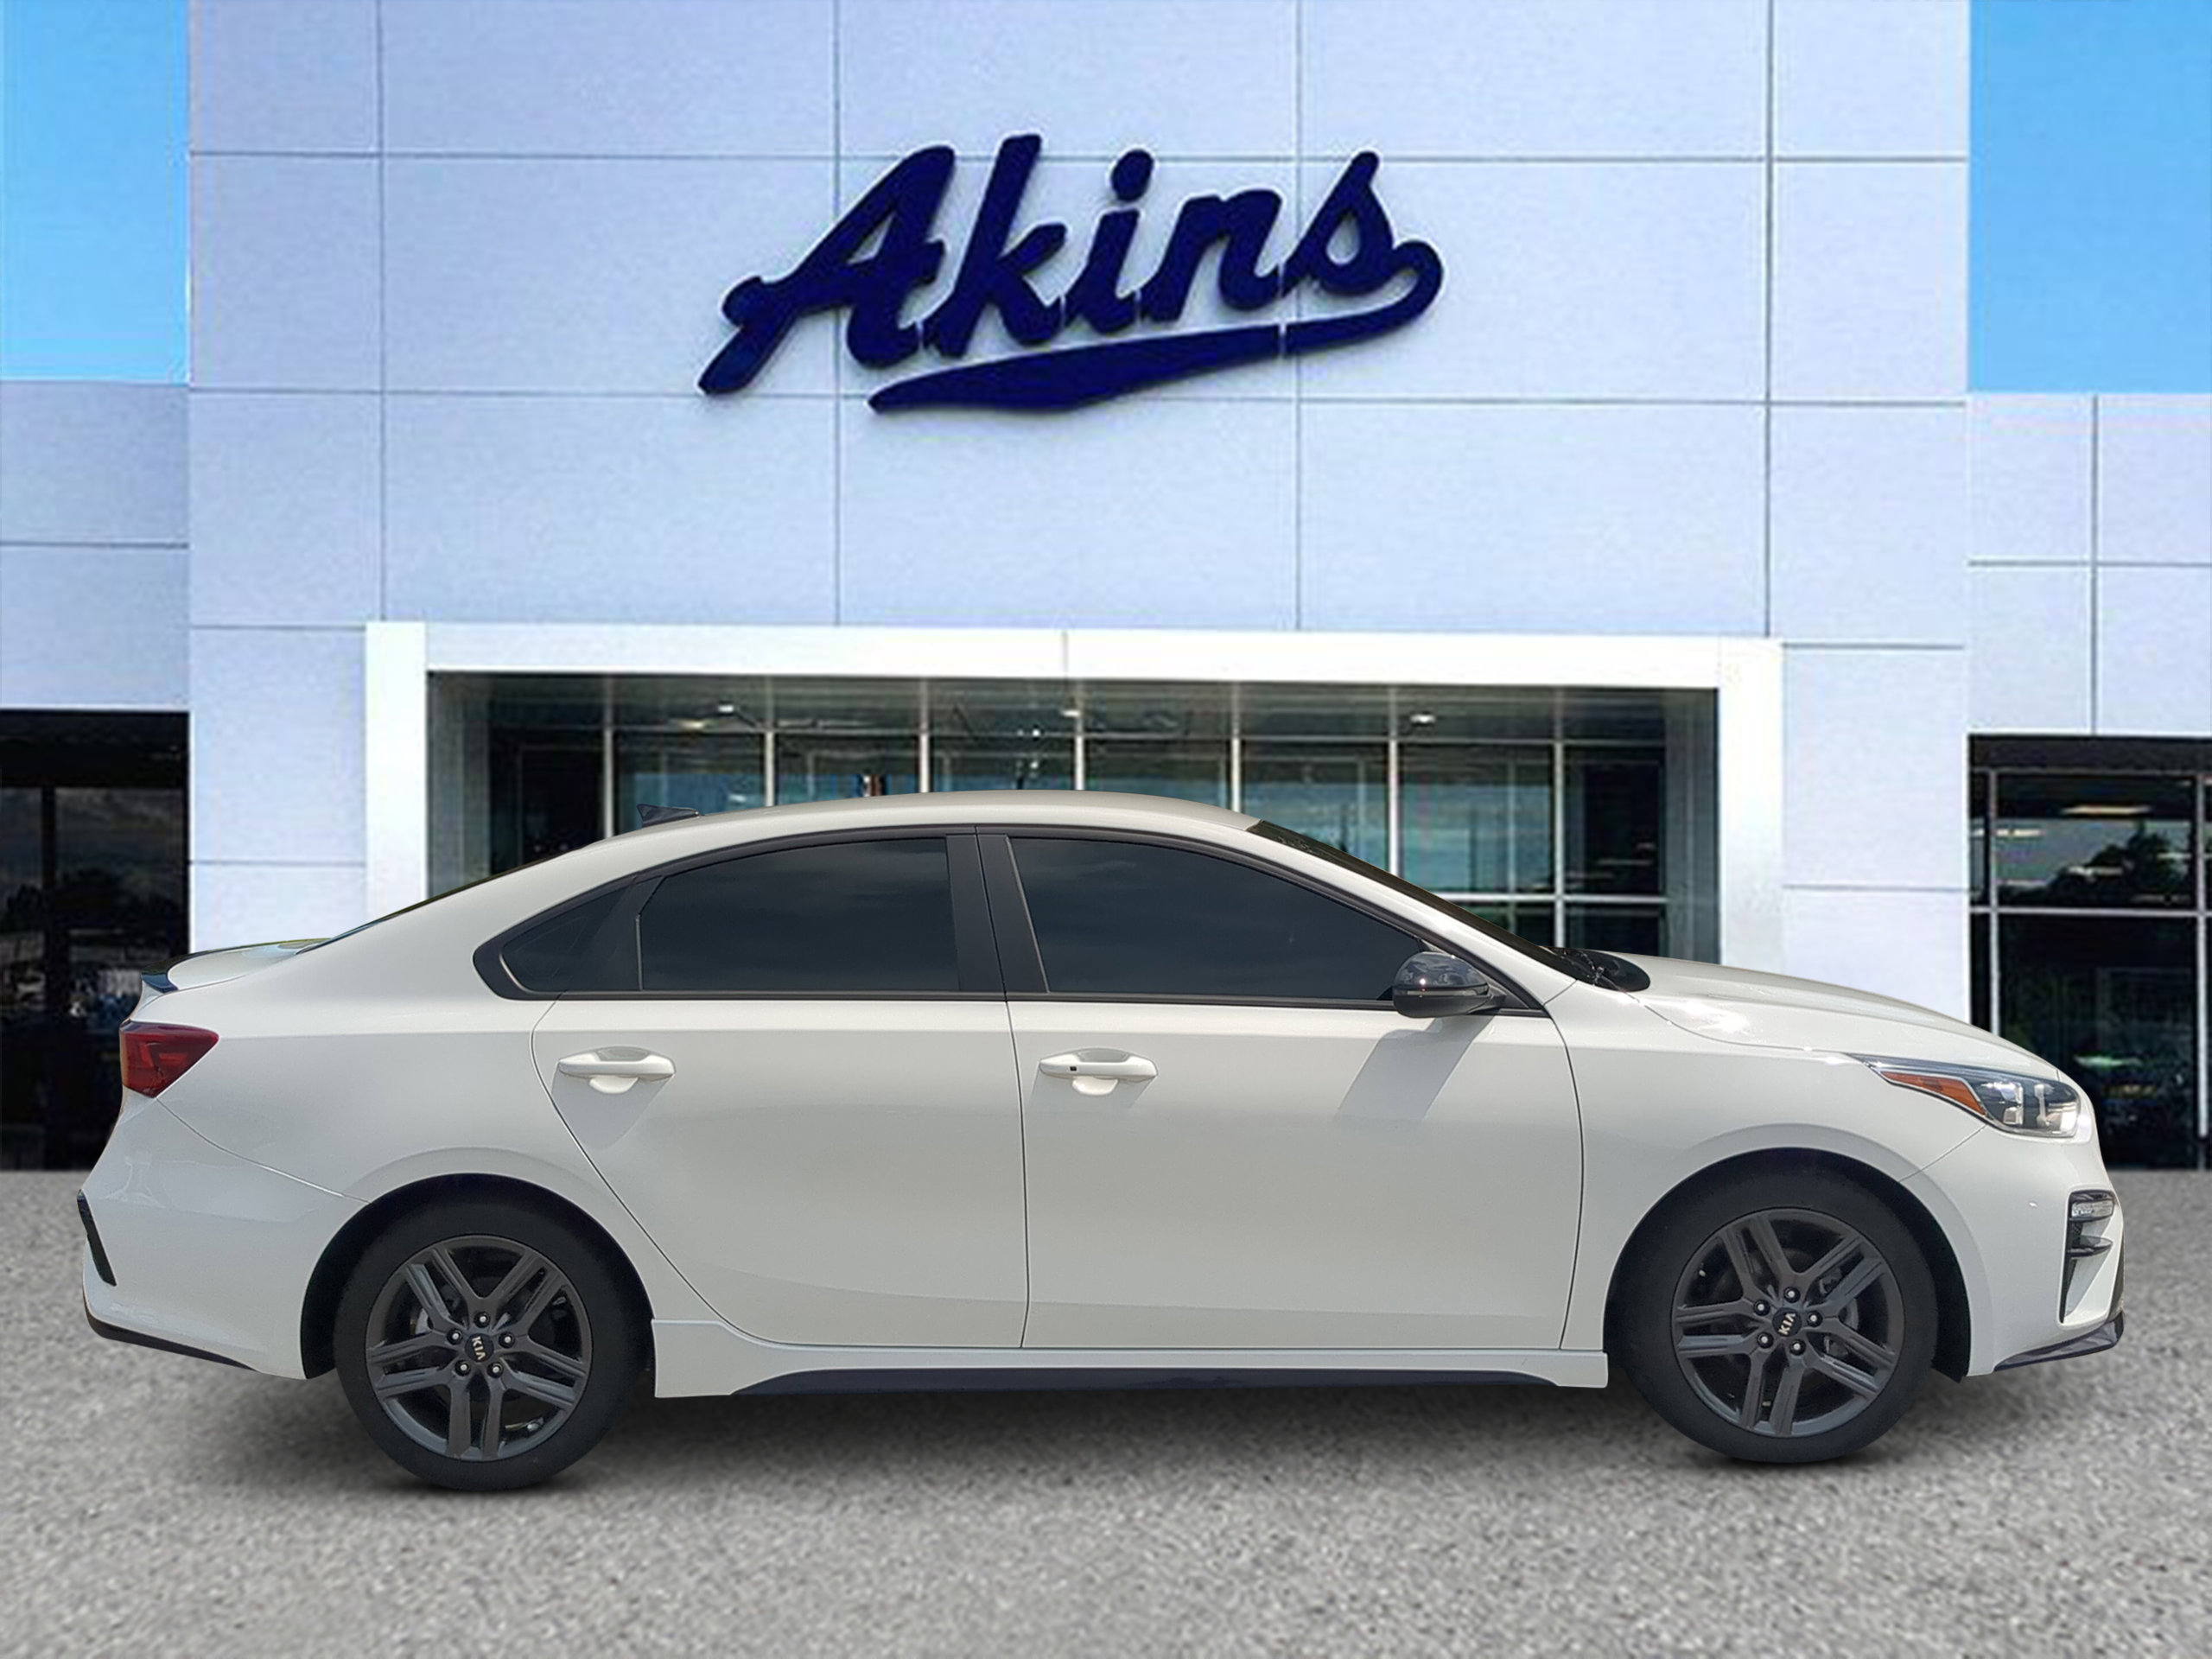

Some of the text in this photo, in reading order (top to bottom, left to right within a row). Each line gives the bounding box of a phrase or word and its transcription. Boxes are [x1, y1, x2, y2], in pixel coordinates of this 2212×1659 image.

[698, 134, 1443, 413] Akins
[1778, 1313, 1796, 1335] KIA
[472, 1336, 486, 1360] KIA
